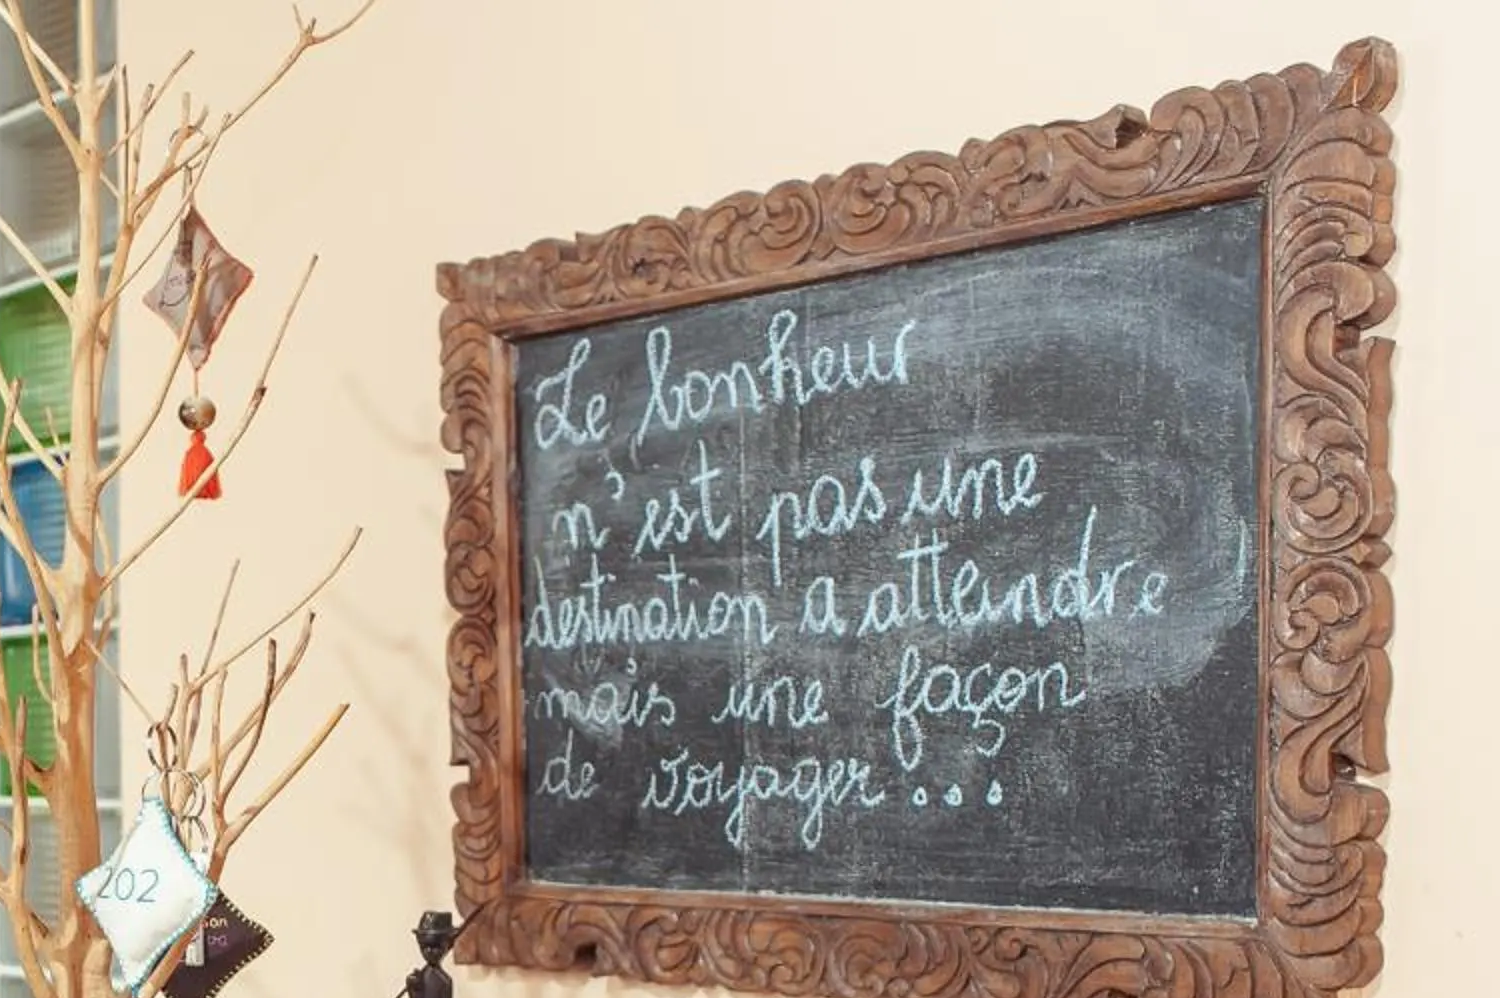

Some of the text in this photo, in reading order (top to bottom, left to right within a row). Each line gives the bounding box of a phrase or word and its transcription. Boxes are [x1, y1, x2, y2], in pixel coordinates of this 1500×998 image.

[534, 309, 916, 449] Le bonheur
[525, 551, 780, 650] destination
[857, 504, 1169, 637] atteindre
[552, 438, 1048, 588] n'est pas une
[534, 645, 1087, 772] mais une façon
[534, 727, 600, 800] de
[97, 866, 159, 903] 202
